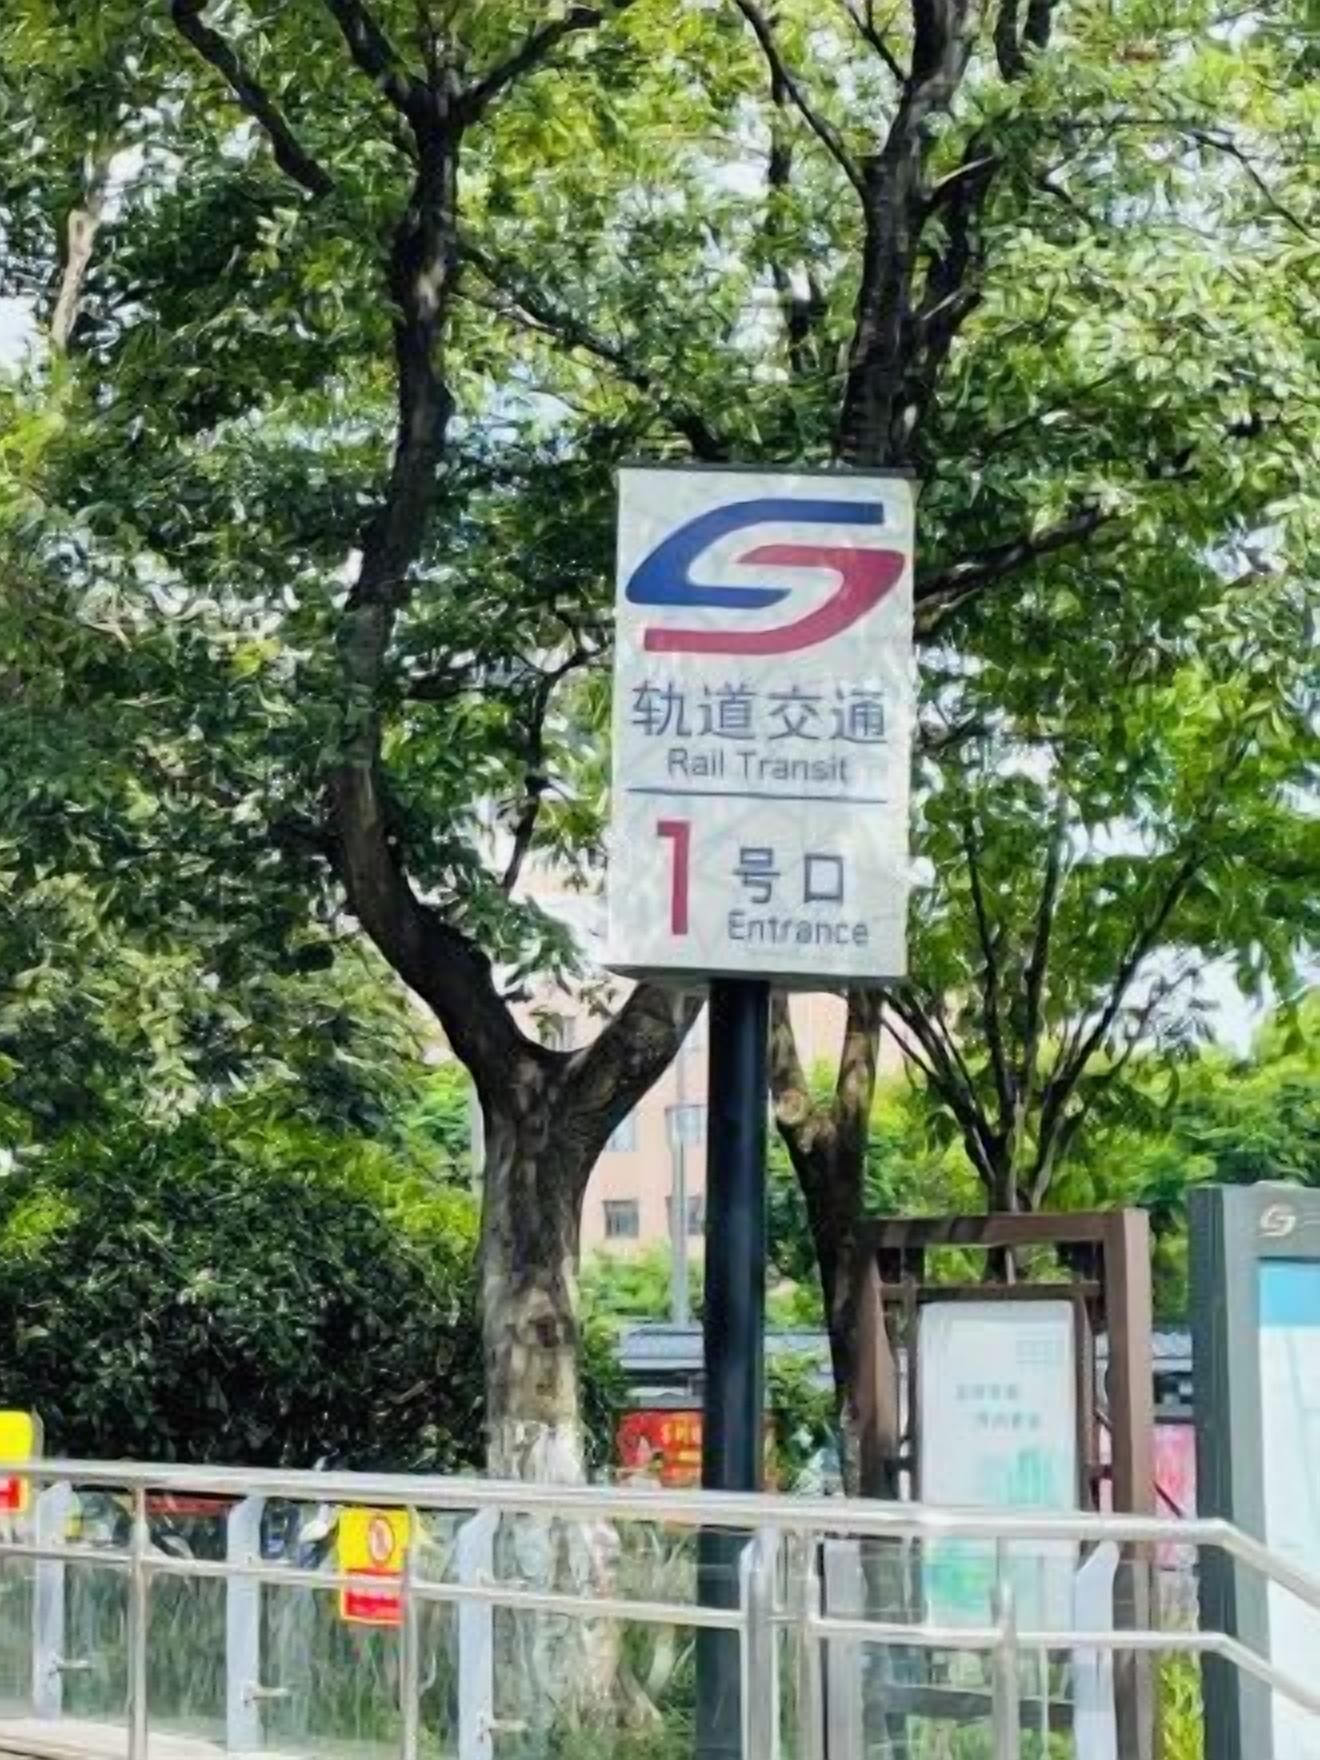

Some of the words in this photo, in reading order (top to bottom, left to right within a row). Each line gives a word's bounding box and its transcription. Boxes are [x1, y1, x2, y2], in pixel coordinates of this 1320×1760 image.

[631, 679, 888, 744] 轨道交通
[667, 747, 724, 778] Rail
[737, 752, 848, 783] Transit
[656, 819, 690, 936] 1
[732, 846, 845, 905] 号口
[728, 909, 869, 947] Entrance
